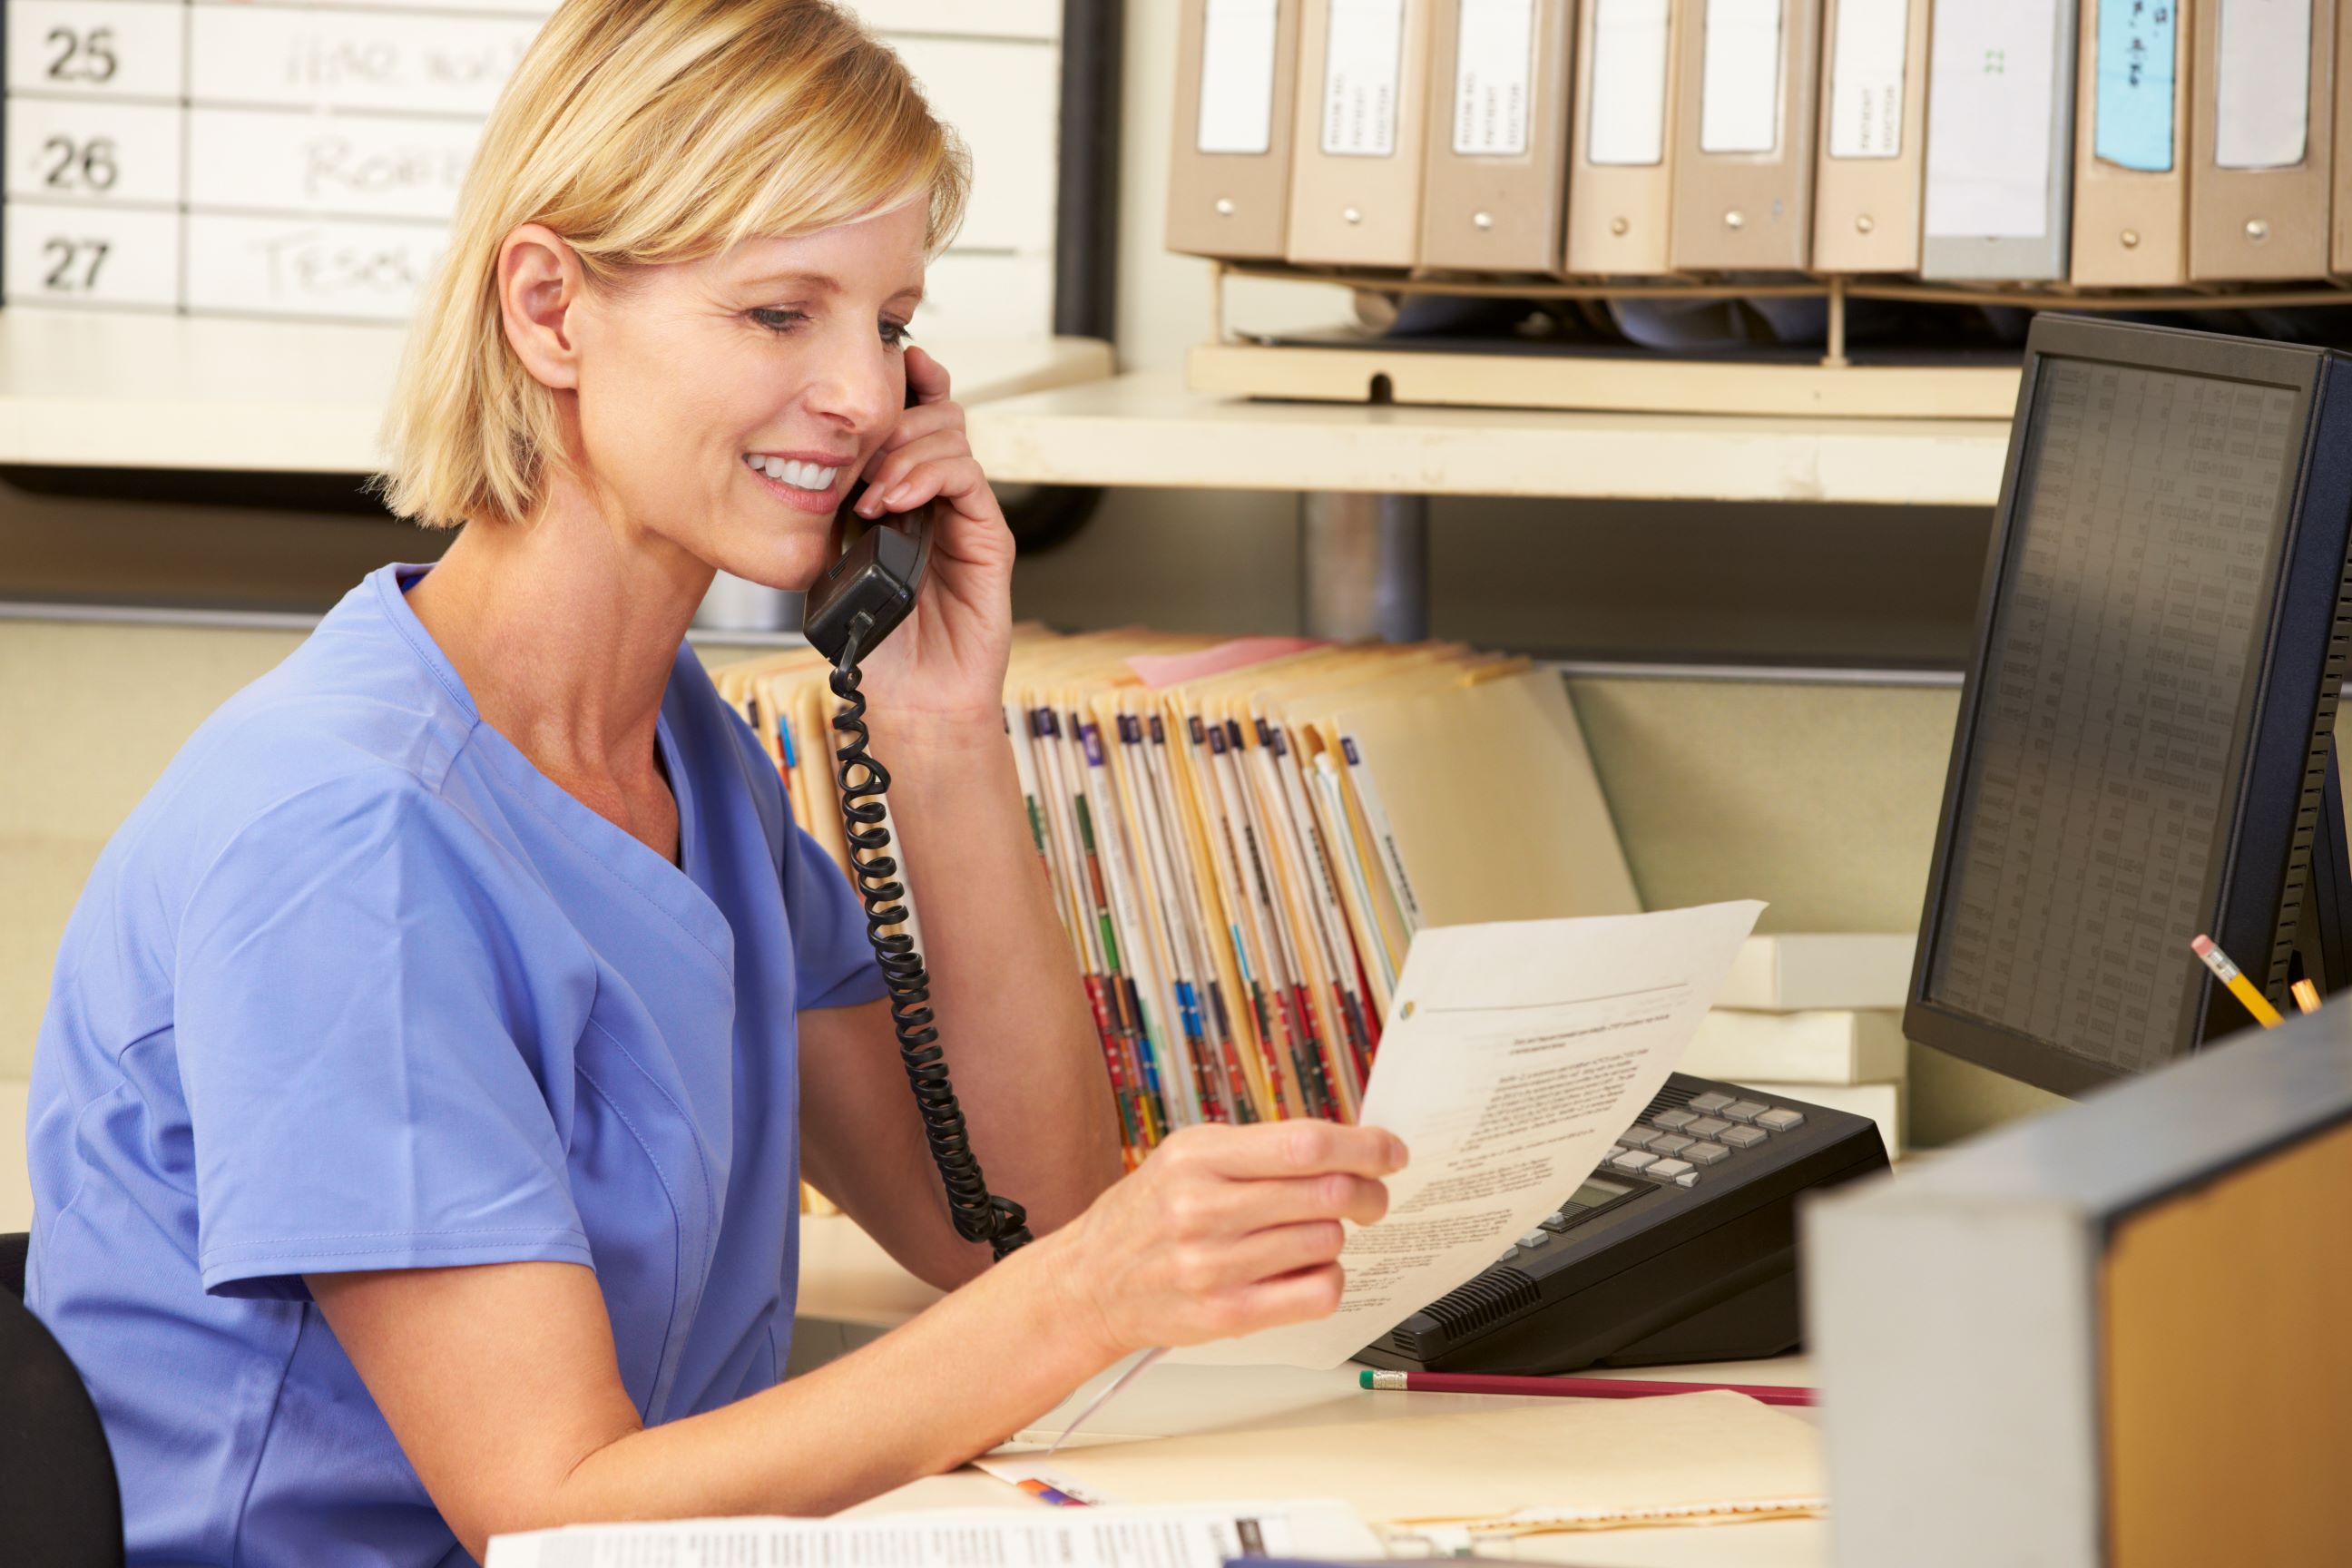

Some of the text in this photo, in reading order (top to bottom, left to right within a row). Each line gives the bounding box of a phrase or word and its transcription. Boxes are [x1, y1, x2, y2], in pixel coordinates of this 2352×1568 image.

[45, 28, 118, 82] 25
[44, 136, 119, 191] 26
[43, 239, 110, 291] 27
